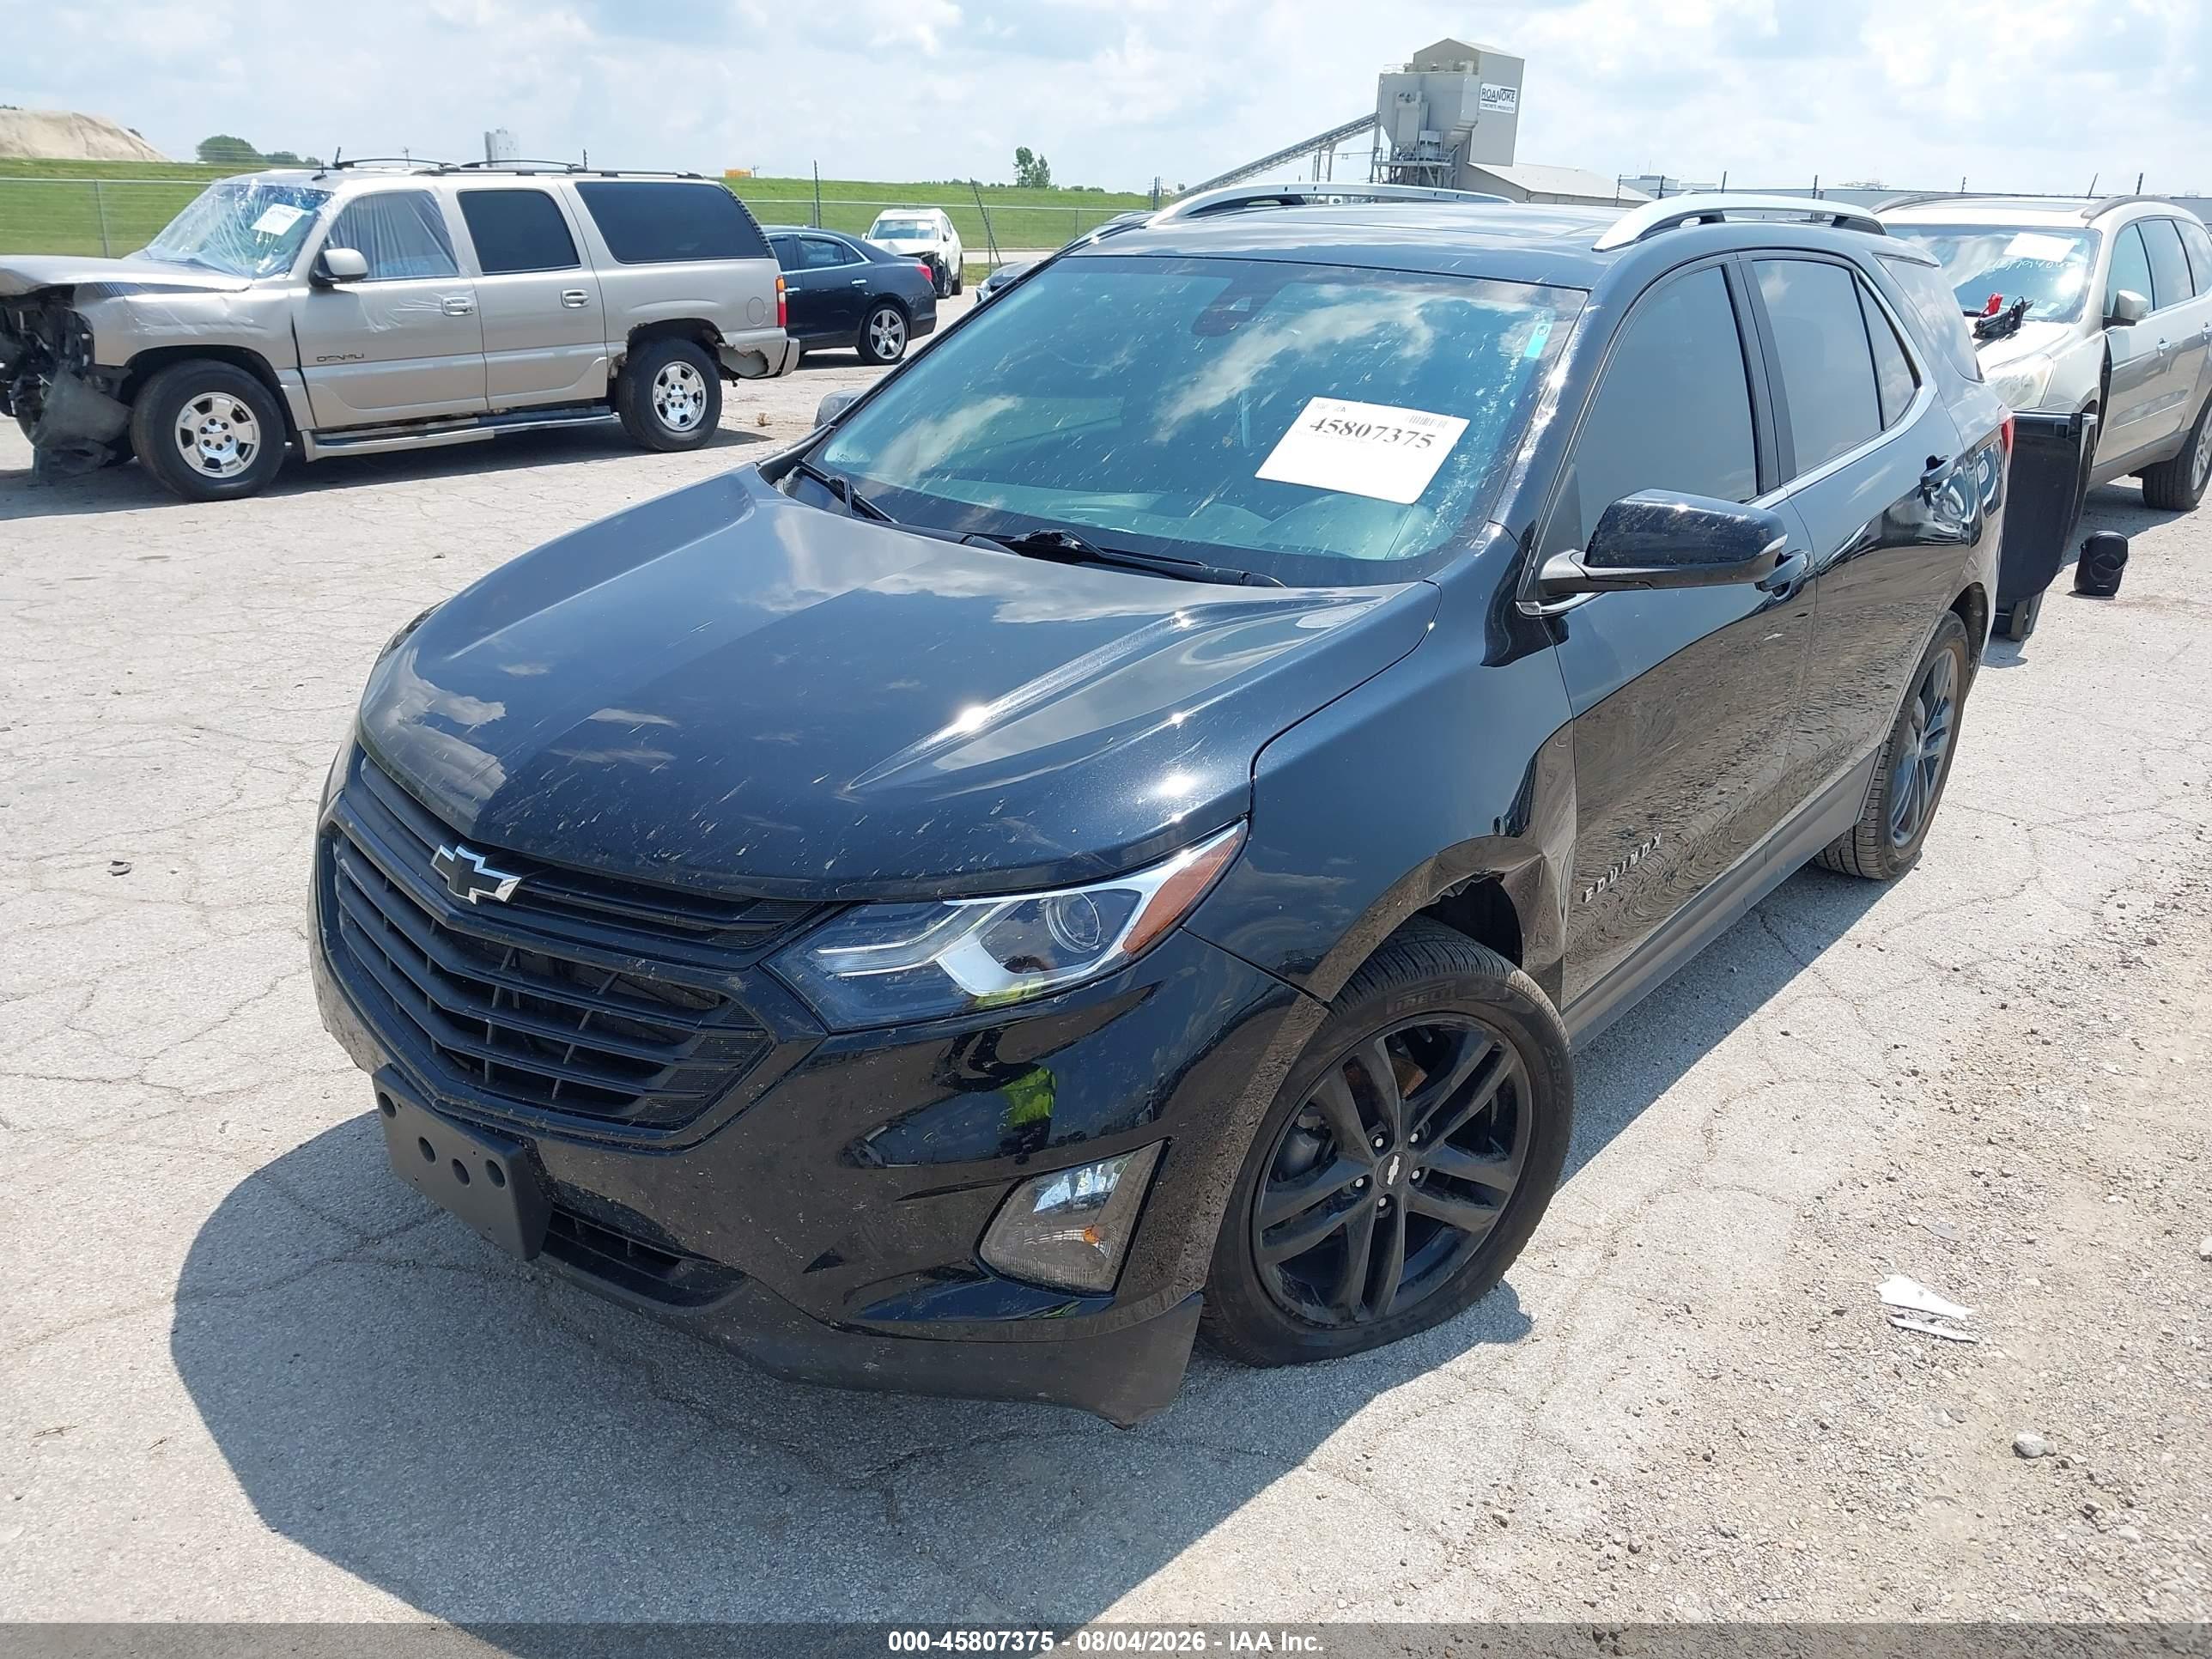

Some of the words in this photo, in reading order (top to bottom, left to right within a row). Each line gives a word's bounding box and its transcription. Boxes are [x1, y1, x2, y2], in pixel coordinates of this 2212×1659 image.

[1481, 88, 1515, 102] ROANOKE
[1309, 416, 1437, 449] 45807375
[1583, 833, 1662, 902] EQUINOX
